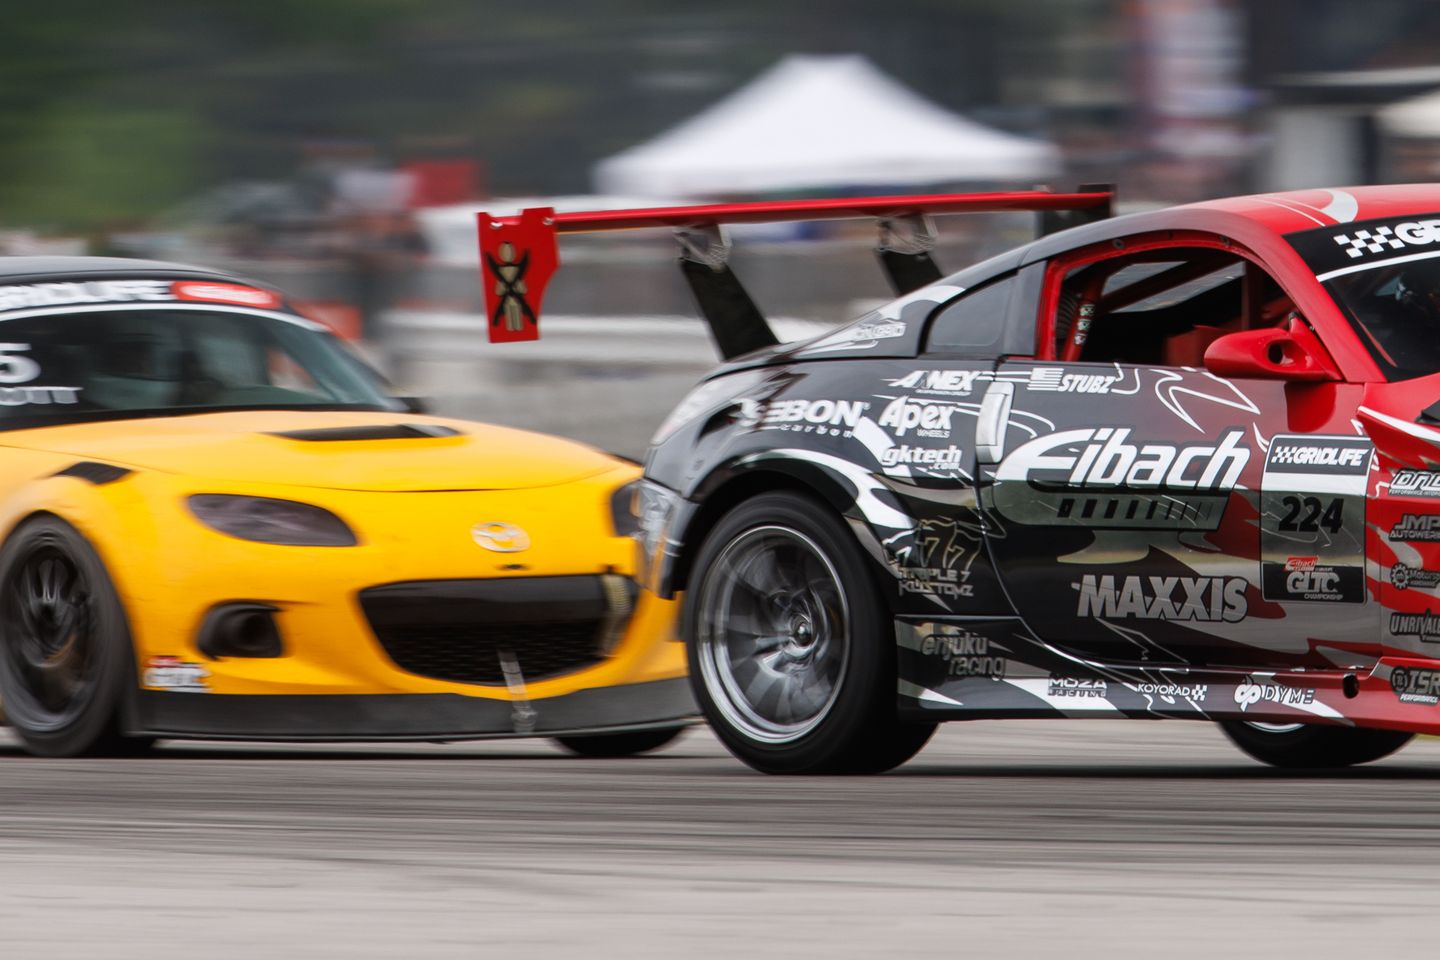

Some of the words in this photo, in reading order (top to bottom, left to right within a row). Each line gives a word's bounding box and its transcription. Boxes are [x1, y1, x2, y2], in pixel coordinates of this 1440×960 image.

[1058, 374, 1116, 393] STUBZ
[878, 395, 956, 436] Apex
[880, 445, 962, 466] gktech
[1292, 446, 1369, 467] GRIDLIFE
[992, 427, 1250, 522] Eibach
[1278, 496, 1345, 534] 224
[1077, 574, 1249, 623] MAXXIS
[1049, 677, 1107, 688] MOZA
[1138, 683, 1190, 696] KOYORAD
[1264, 685, 1315, 704] DYME
